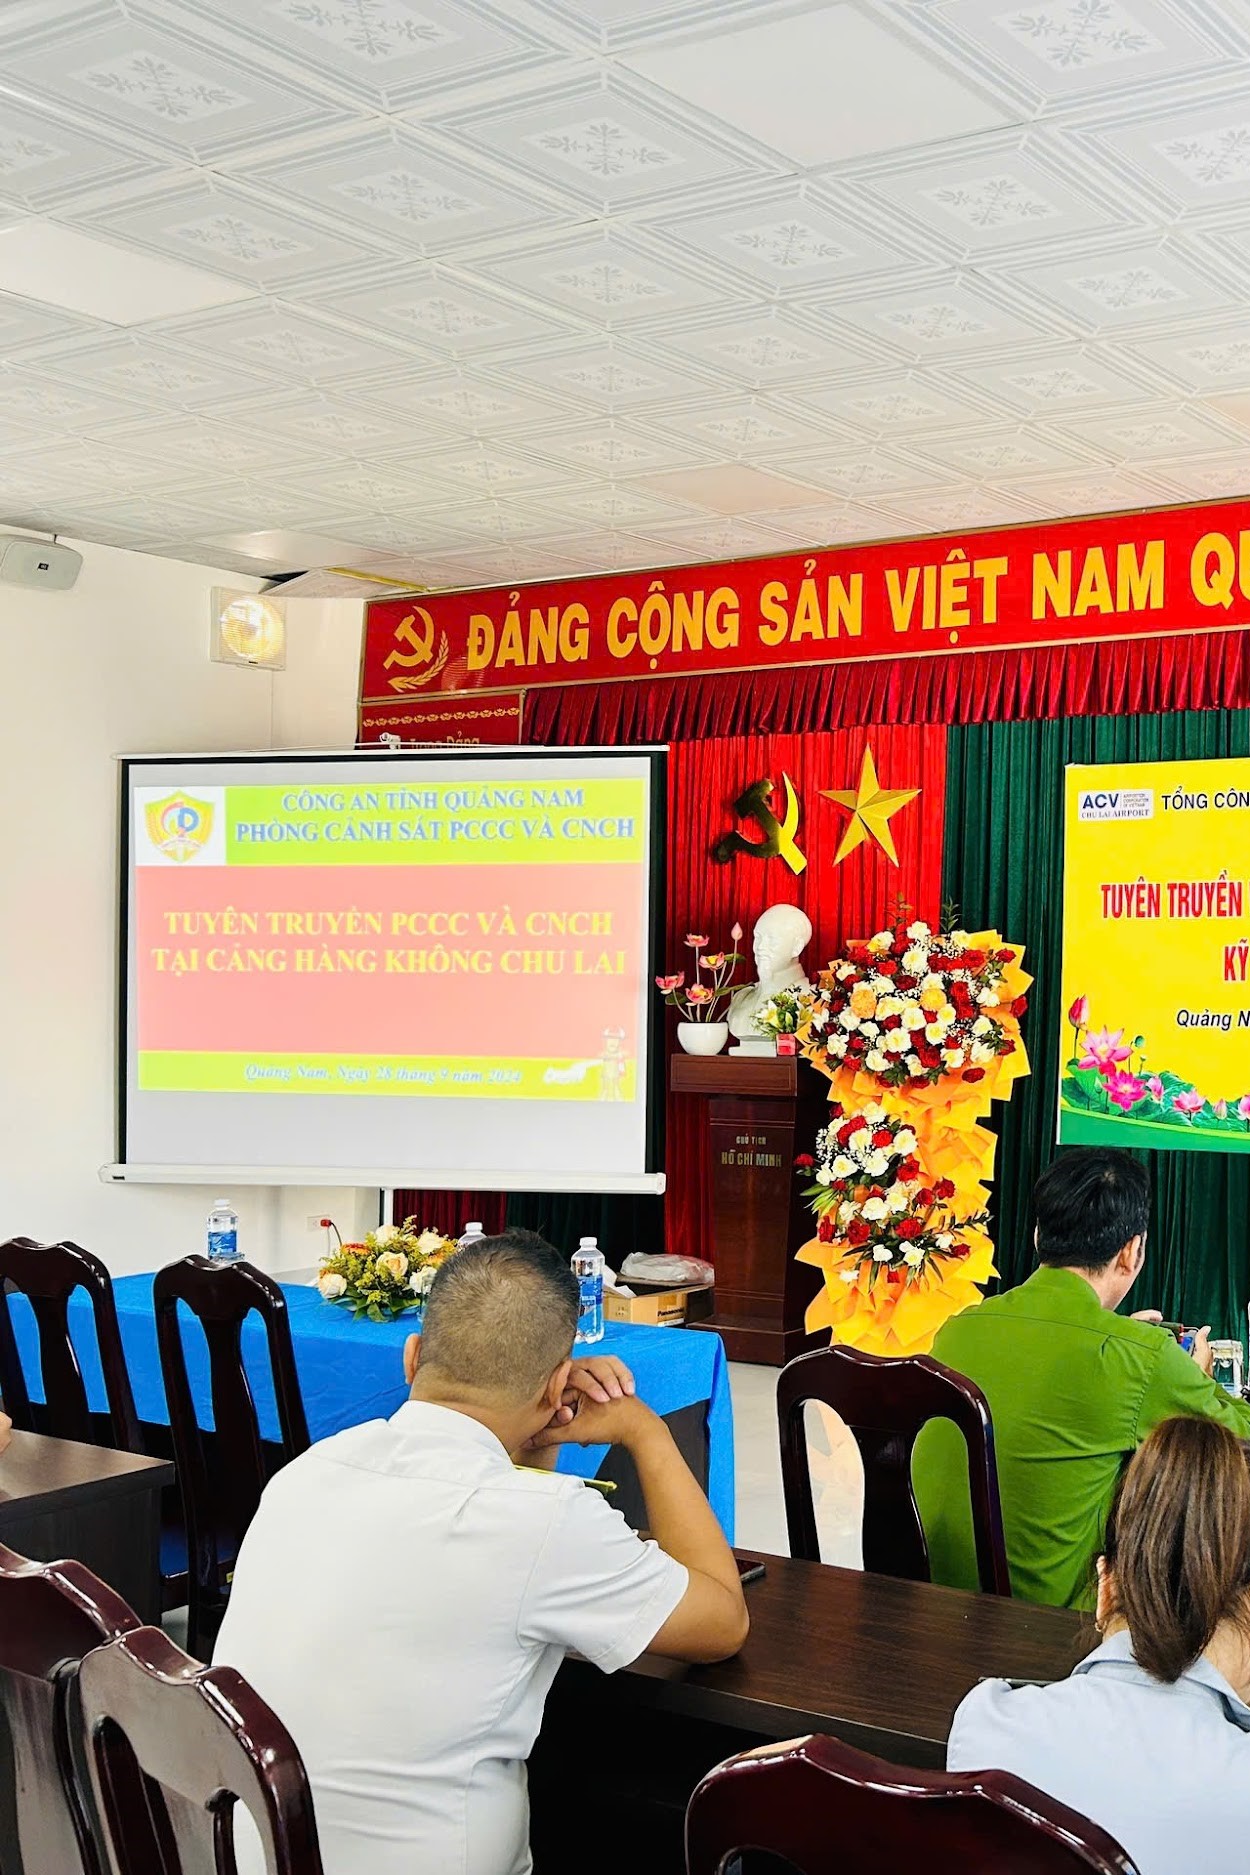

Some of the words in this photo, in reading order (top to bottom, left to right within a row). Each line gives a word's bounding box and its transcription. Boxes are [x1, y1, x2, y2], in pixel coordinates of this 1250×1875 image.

[464, 592, 589, 670] ĐẢNG
[607, 581, 742, 671] CỘNG
[759, 559, 862, 645] SẢN
[885, 549, 1007, 643] VIỆT
[1033, 540, 1164, 619] NAM
[350, 792, 381, 811] AN
[530, 789, 585, 809] NAM
[1082, 793, 1119, 809] ACV
[1162, 786, 1207, 809] TỔNG
[1112, 809, 1150, 818] AIRPORT
[451, 819, 518, 843] PCCC
[562, 817, 635, 841] CNCH
[1101, 875, 1161, 920] TUYÊN
[1168, 869, 1243, 918] TRUYỀN
[391, 913, 470, 937] PCCC
[526, 912, 613, 937] CNCH
[499, 949, 567, 976] CHU
[574, 950, 626, 976] LAI
[1223, 940, 1250, 981] KỸ
[1177, 1009, 1231, 1031] Quảng
[737, 1150, 753, 1165] CHÍ
[756, 1154, 782, 1167] MINH
